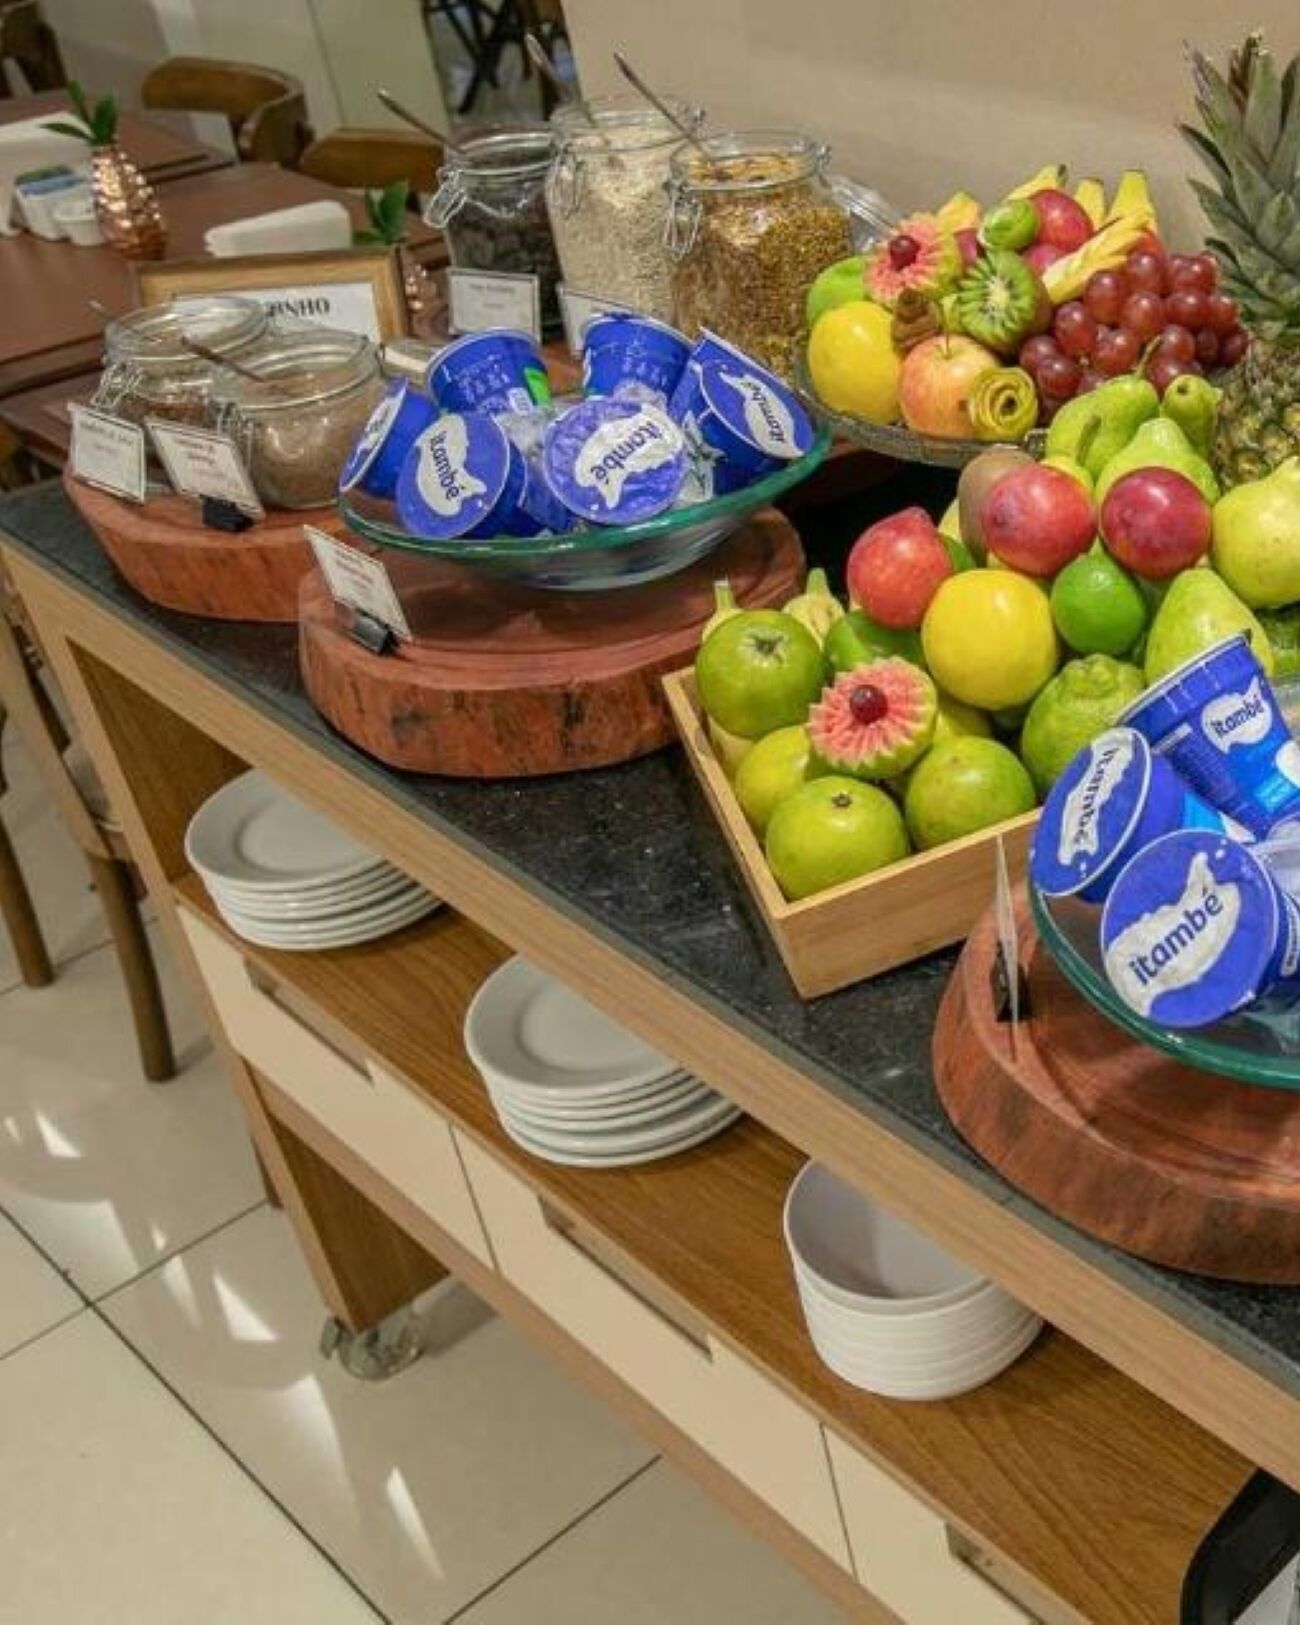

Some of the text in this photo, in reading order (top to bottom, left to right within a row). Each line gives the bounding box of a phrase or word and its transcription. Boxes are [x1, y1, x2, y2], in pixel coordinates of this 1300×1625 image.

[430, 430, 466, 500] itambé
[591, 419, 664, 486] itambé
[1210, 693, 1265, 738] itambé
[1074, 747, 1120, 845] itambé
[1128, 887, 1224, 985] itambé
